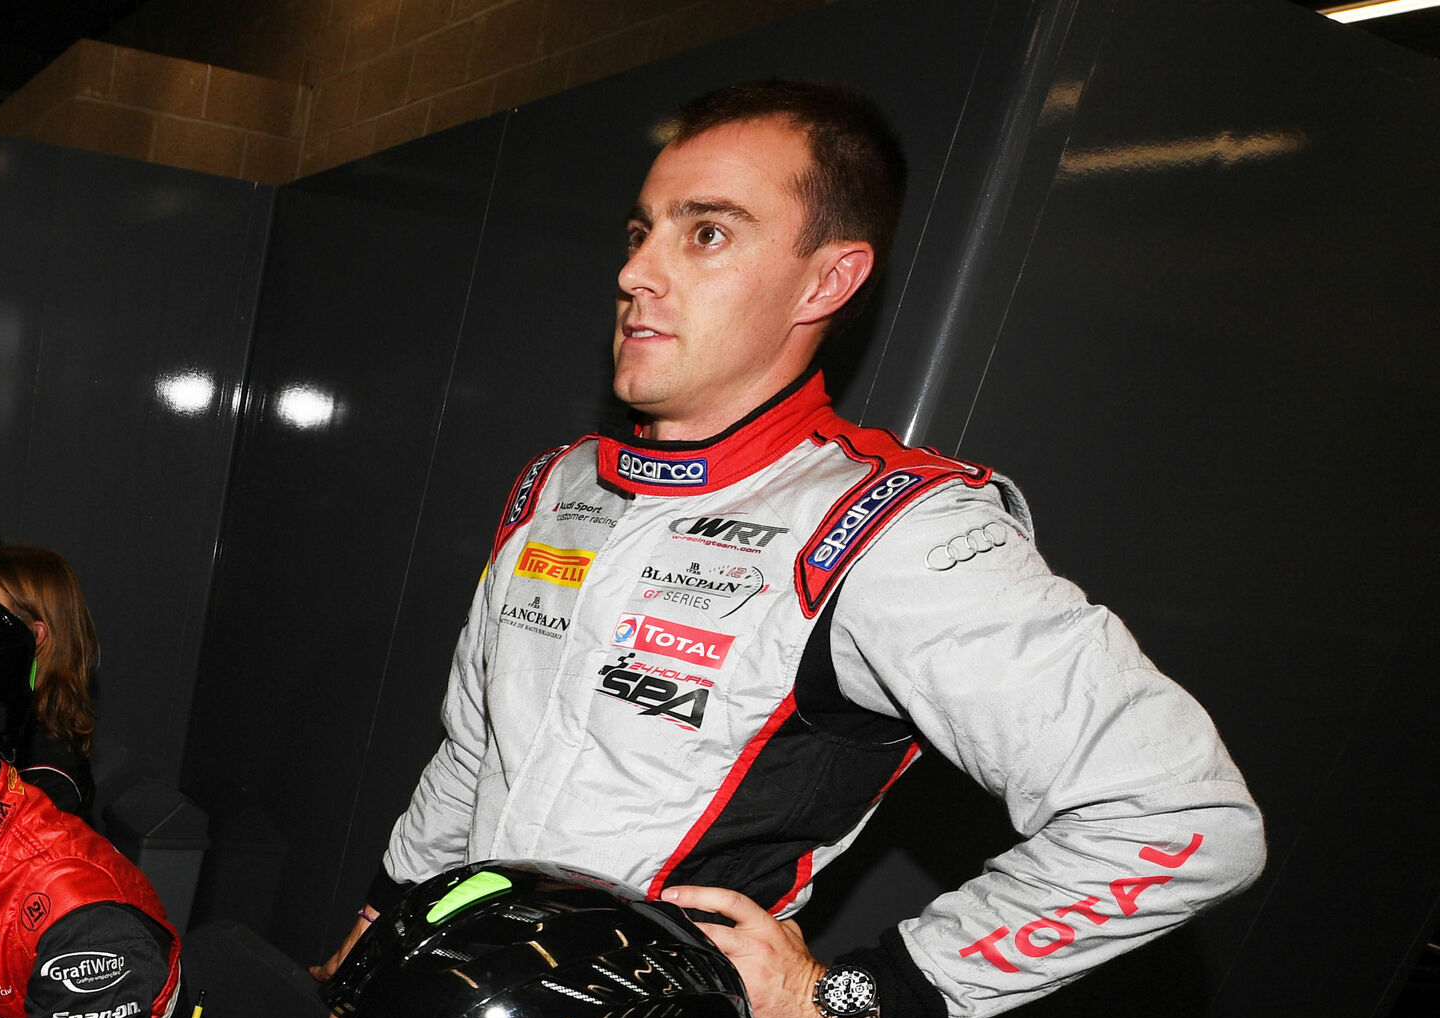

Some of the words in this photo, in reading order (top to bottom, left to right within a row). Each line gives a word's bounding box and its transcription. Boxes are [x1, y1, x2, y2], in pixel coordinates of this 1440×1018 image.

[618, 453, 704, 480] sparco
[574, 502, 603, 514] Sport
[812, 472, 914, 569] sparco
[590, 517, 619, 529] racing
[686, 517, 790, 547] WRT
[518, 548, 591, 582] PIRELLI
[641, 566, 742, 593] BLANCPAIN
[643, 590, 663, 599] GT
[663, 591, 711, 610] SERIES
[501, 604, 571, 631] LANCPAIN
[645, 624, 720, 660] TOTAL
[628, 662, 652, 673] 24
[652, 667, 715, 688] HOURS
[602, 670, 709, 728] SPA
[960, 833, 1205, 974] TOTAL
[50, 953, 125, 981] GrafiWrap
